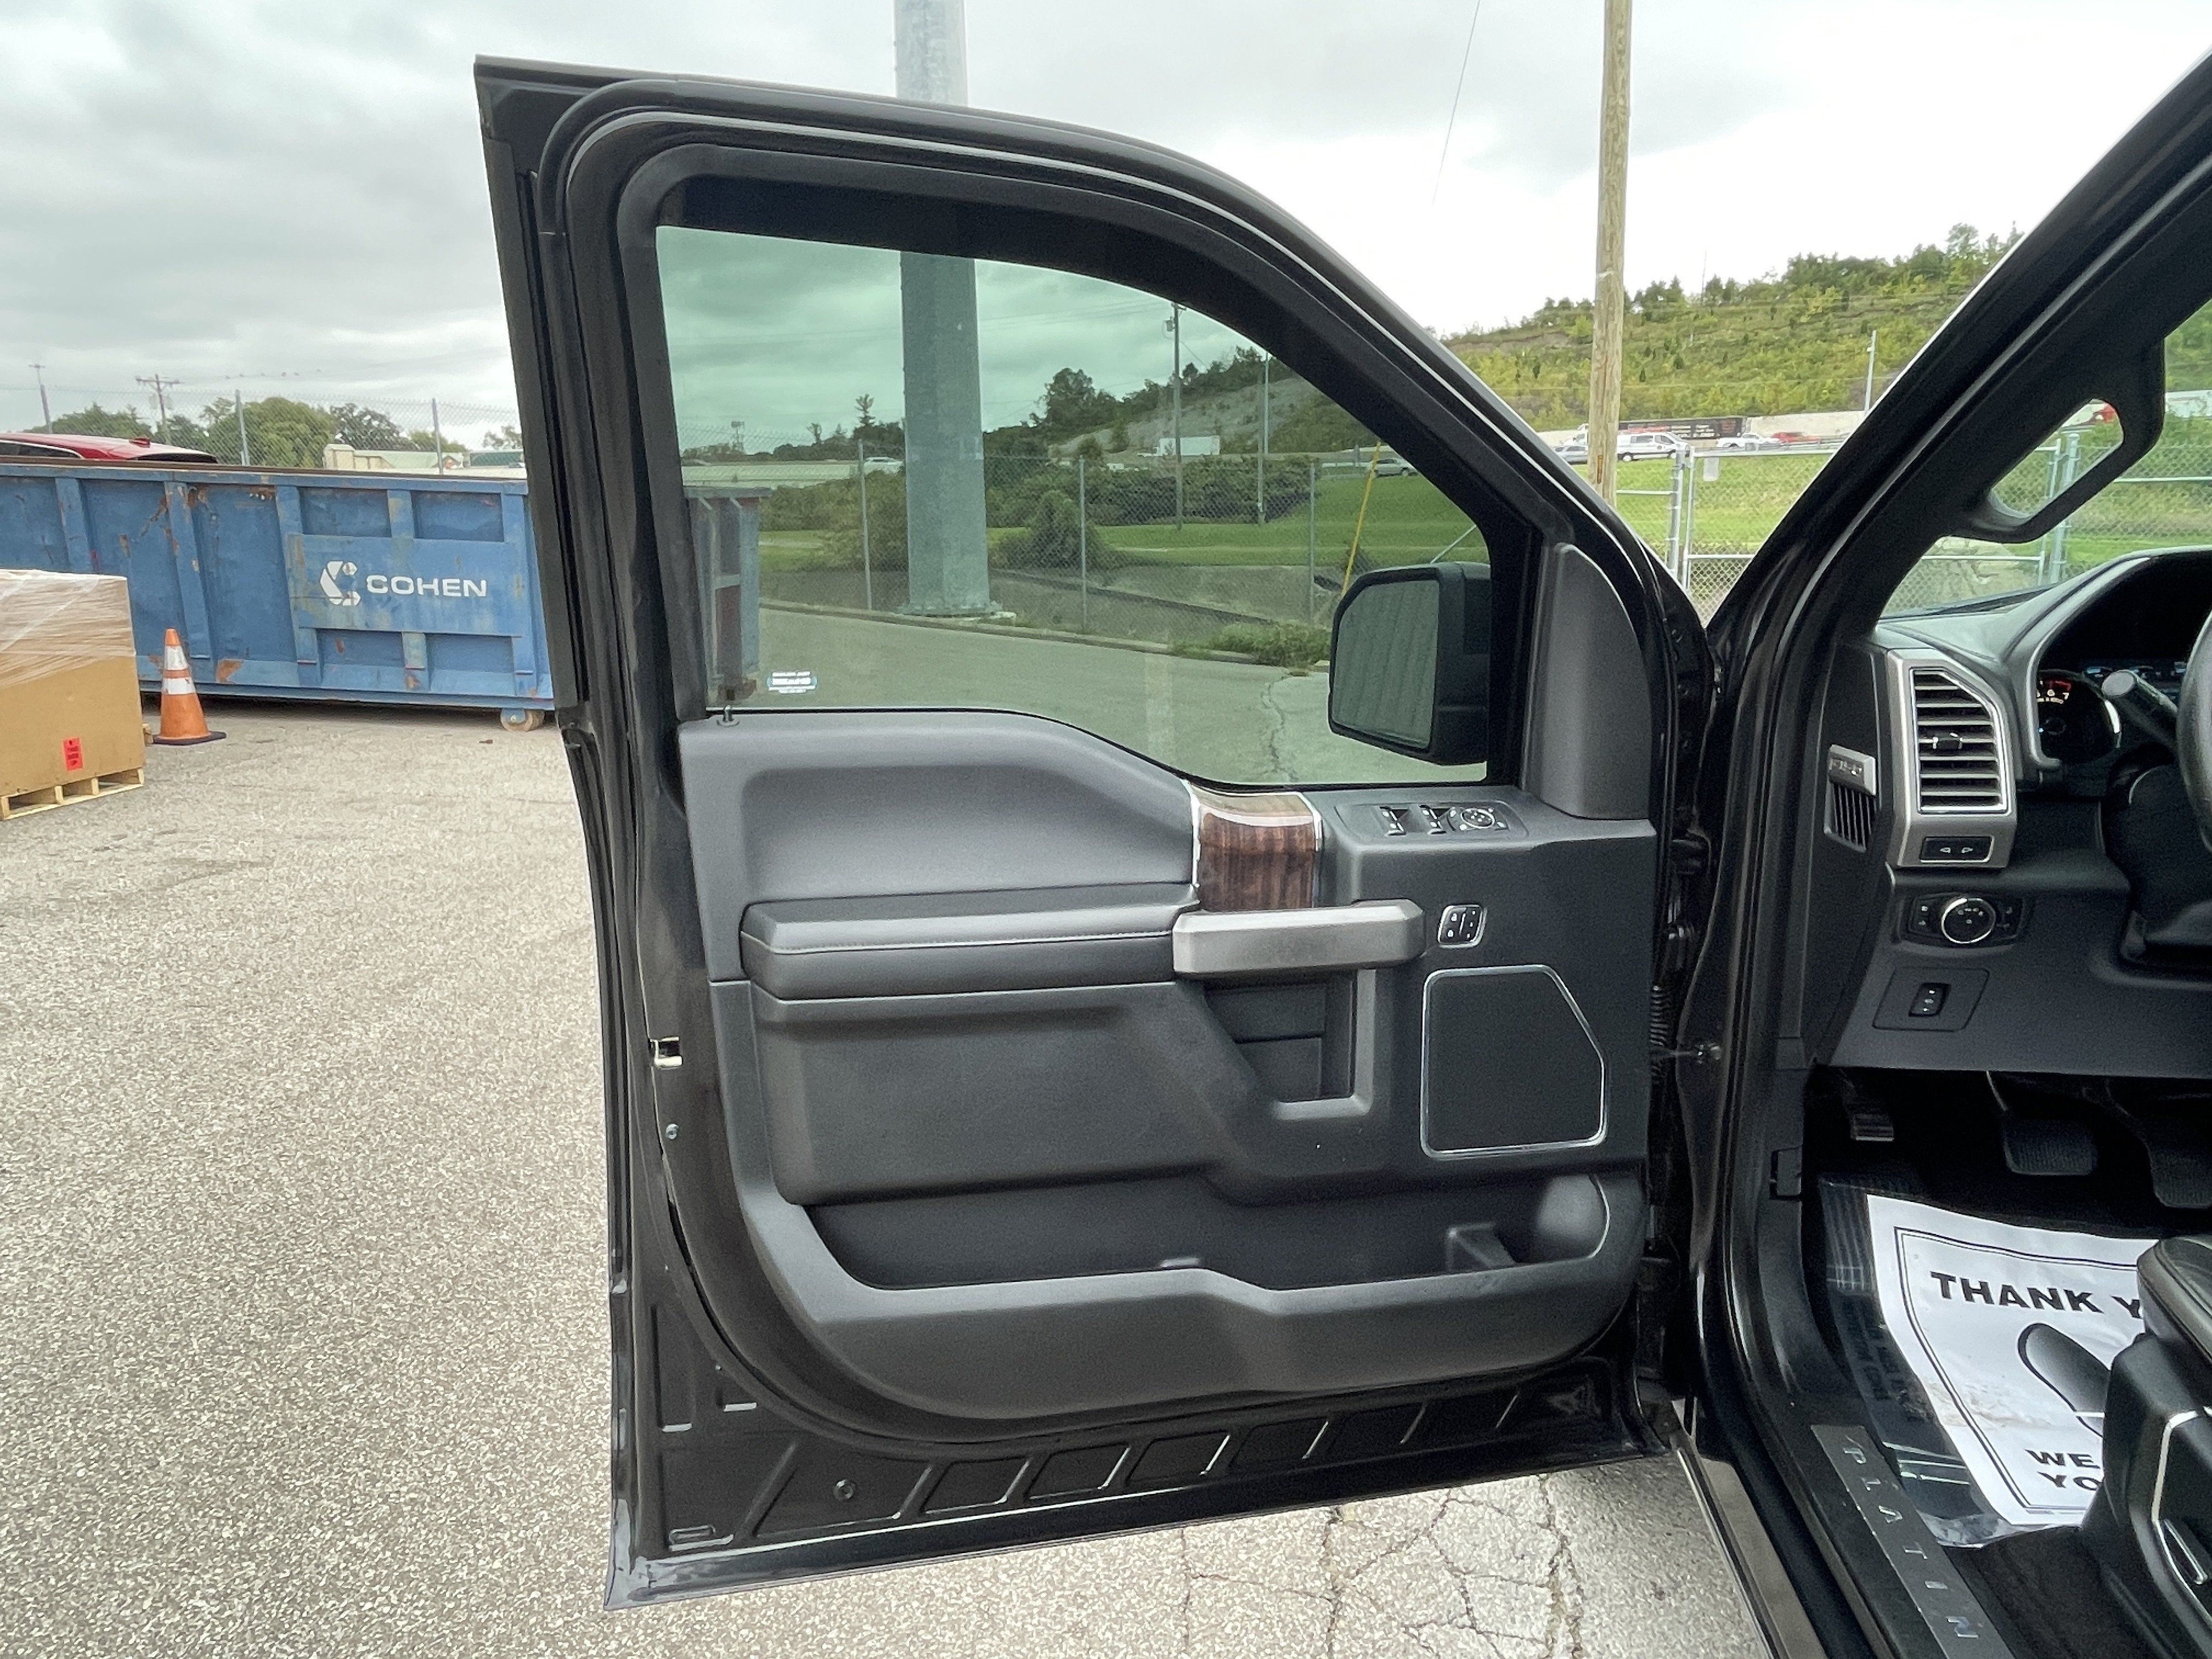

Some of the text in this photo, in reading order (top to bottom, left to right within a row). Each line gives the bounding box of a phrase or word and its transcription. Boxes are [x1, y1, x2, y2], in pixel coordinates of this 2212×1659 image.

[366, 575, 487, 597] COHEN
[1930, 1271, 2104, 1313] THANK
[2024, 1449, 2100, 1469] WE
